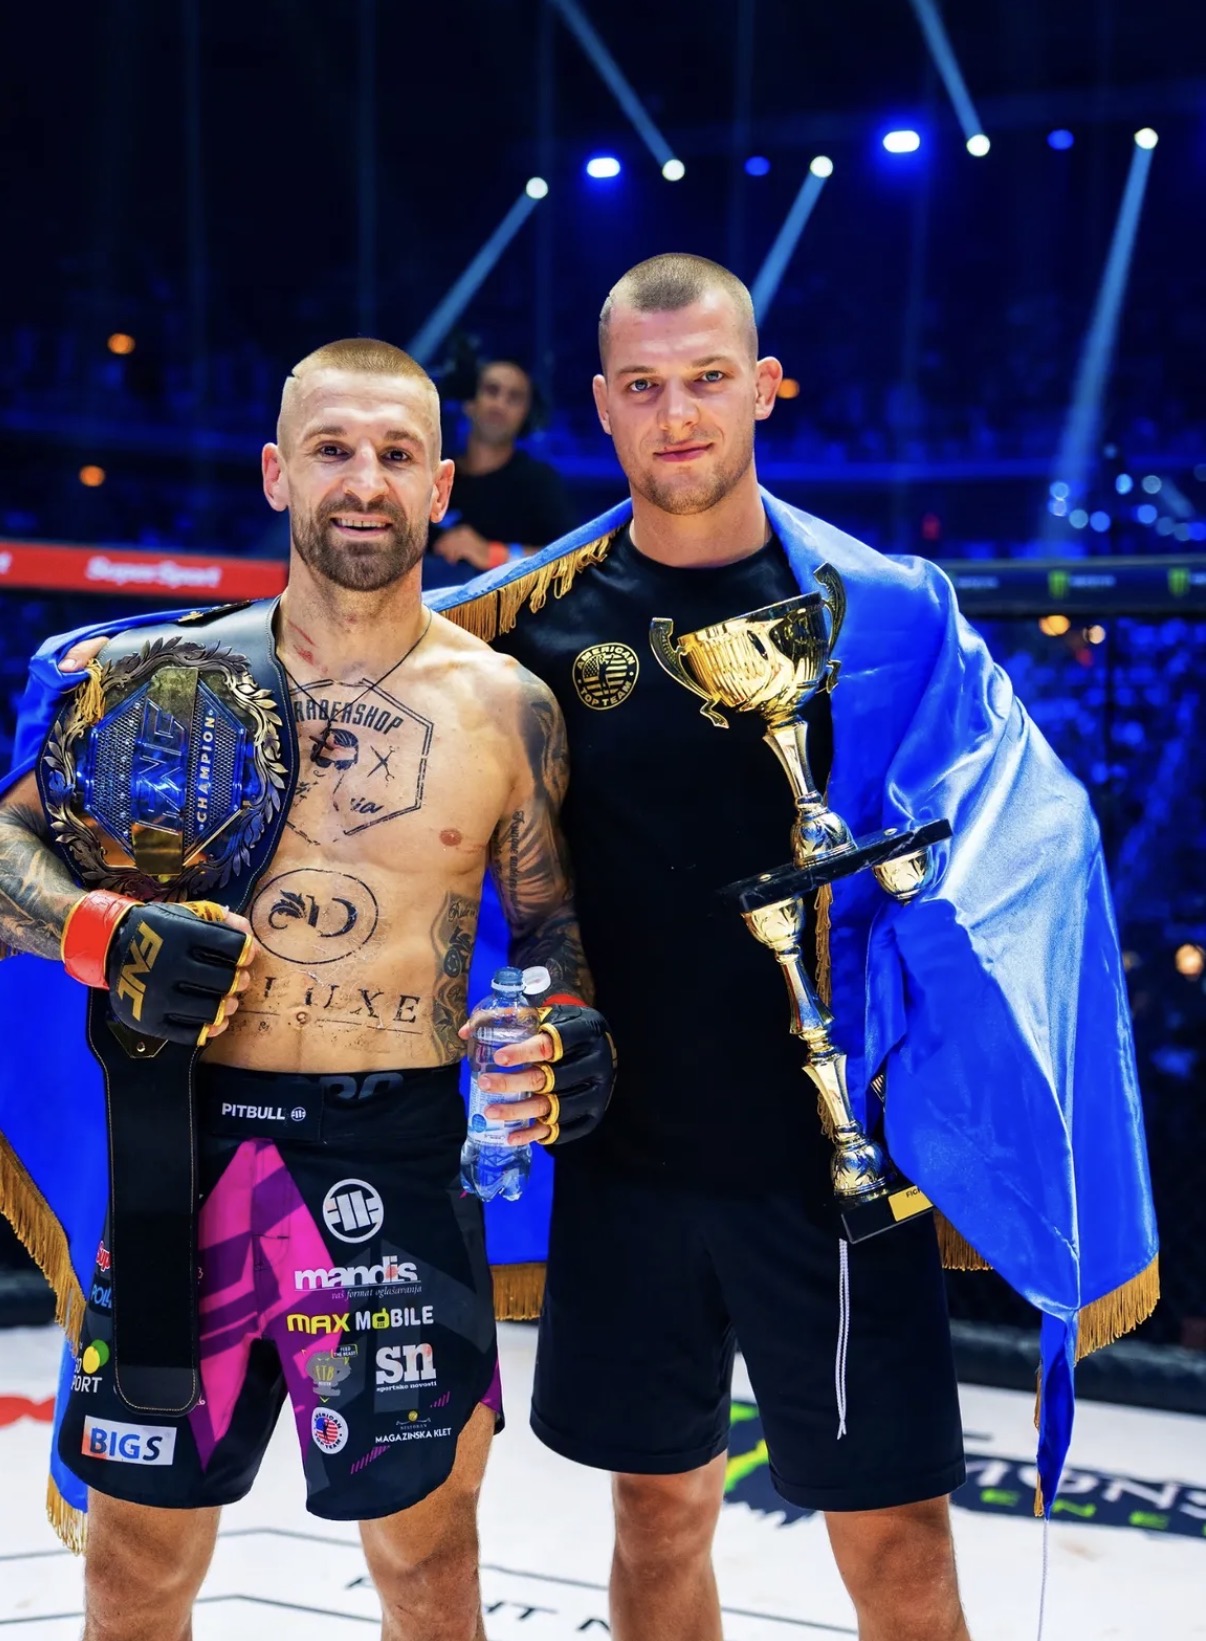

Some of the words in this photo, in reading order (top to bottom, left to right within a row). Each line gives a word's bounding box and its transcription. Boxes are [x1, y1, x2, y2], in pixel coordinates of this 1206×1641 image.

[577, 646, 636, 670] AMERICAN
[580, 687, 600, 706] TOP
[602, 681, 632, 706] TEAM
[293, 699, 404, 735] ARBERSHOP
[196, 716, 216, 823] CHAMPION
[221, 1102, 286, 1120] PITBULL
[294, 1255, 418, 1290] mandis
[344, 1288, 374, 1302] format
[287, 1313, 351, 1335] MAX
[410, 1380, 437, 1389] novosti
[90, 1427, 163, 1461] BIGS
[375, 1430, 432, 1443] MAGAZINSKA
[433, 1427, 452, 1438] KLET
